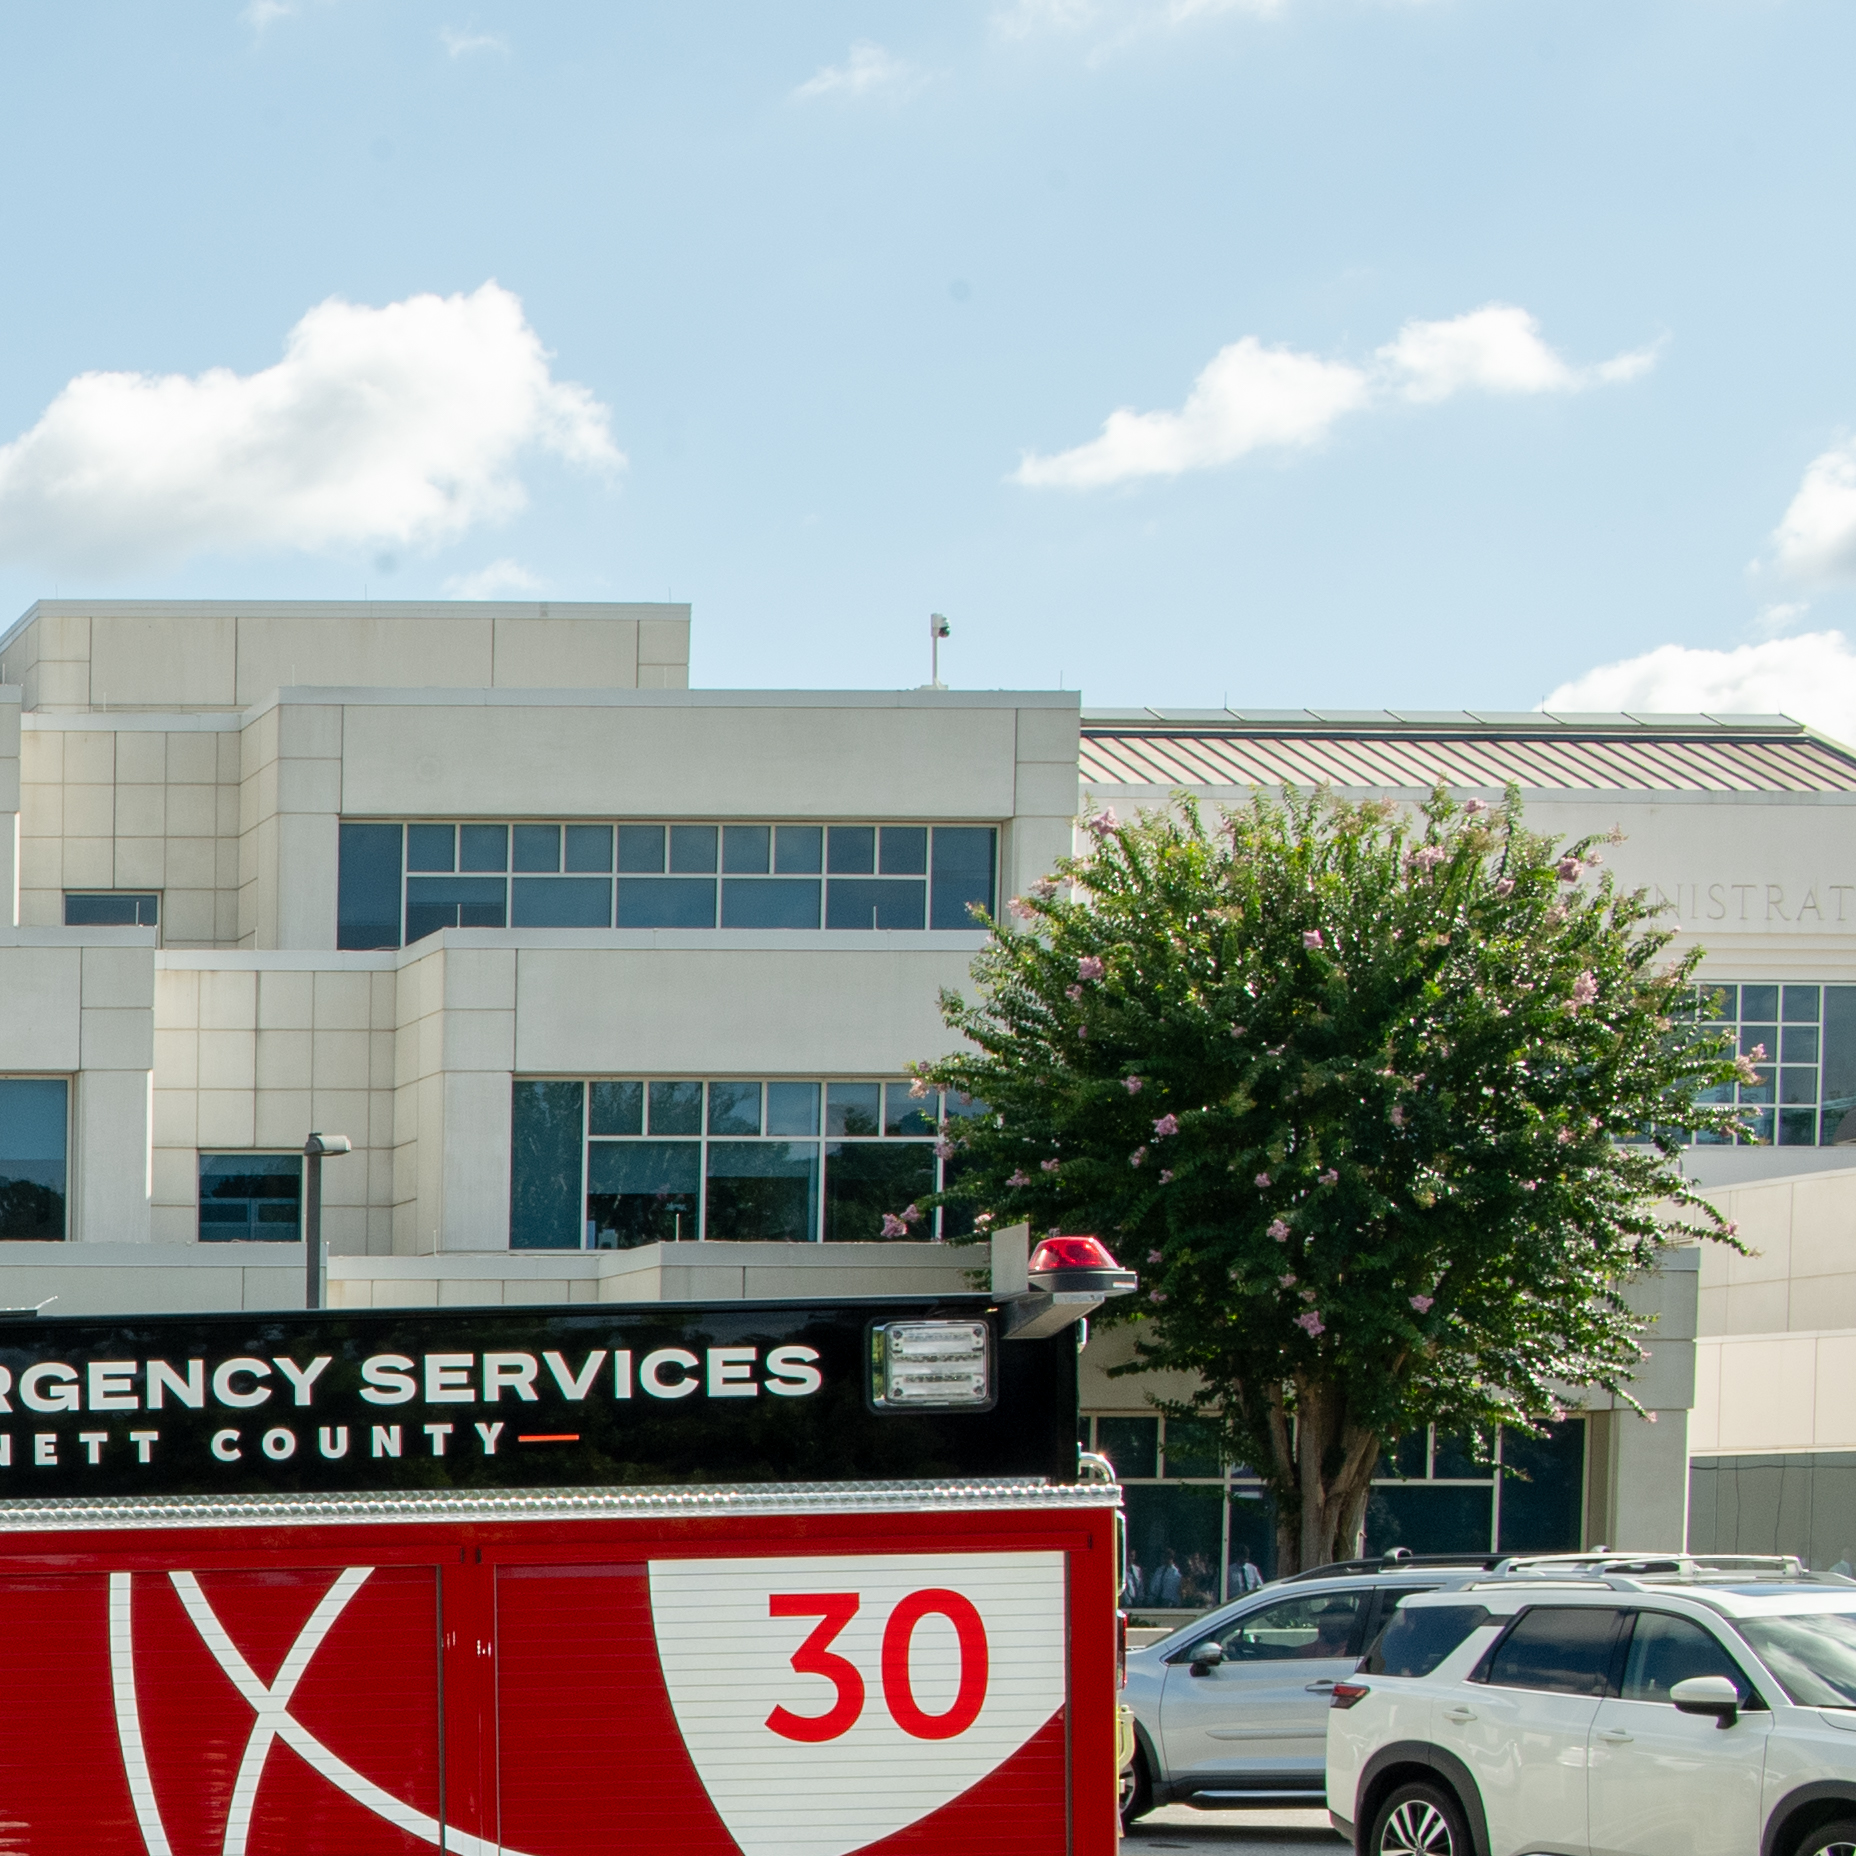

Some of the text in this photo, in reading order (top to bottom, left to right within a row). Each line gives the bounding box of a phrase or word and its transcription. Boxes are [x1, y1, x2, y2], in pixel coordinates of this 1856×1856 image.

[360, 1345, 822, 1406] SERVICES
[211, 1421, 505, 1462] COUNTY
[764, 1588, 989, 1743] 30
